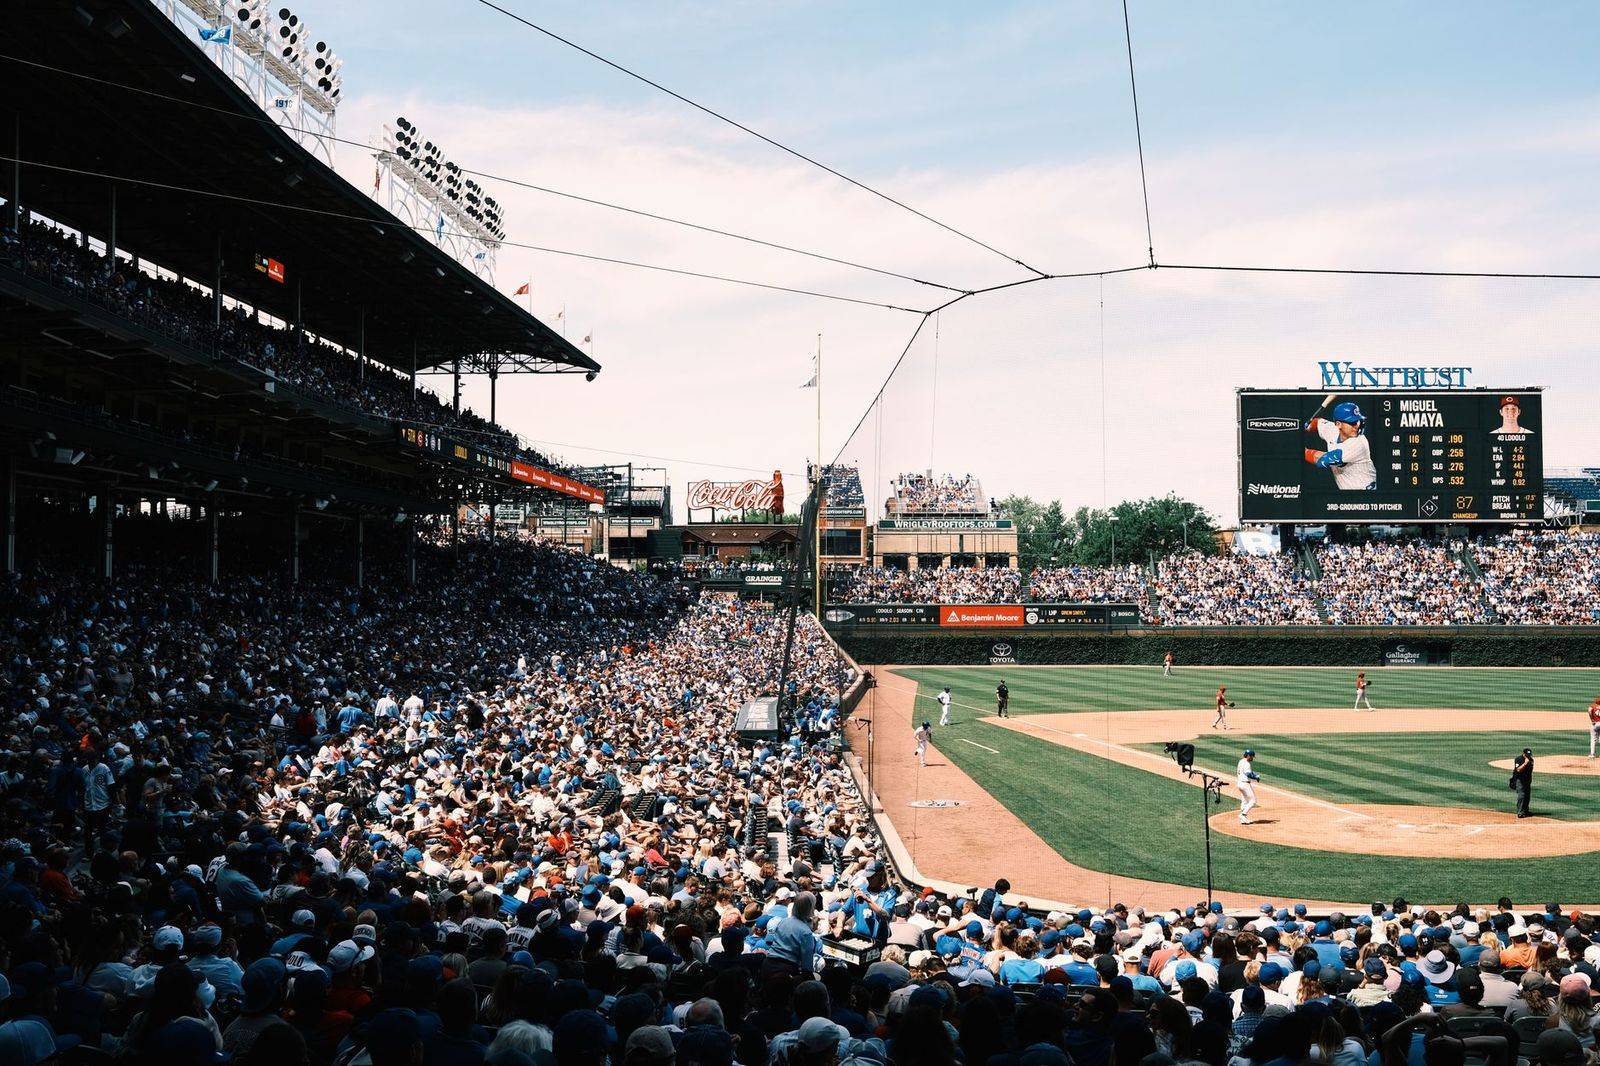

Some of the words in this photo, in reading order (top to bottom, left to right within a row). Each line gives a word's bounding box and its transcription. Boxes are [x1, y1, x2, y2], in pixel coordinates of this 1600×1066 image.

[1318, 362, 1472, 388] WINTRUST
[1384, 400, 1390, 412] 9
[1400, 400, 1438, 412] MIGUEL
[1384, 418, 1390, 426] C
[1400, 412, 1444, 428] AMAYA
[1409, 434, 1420, 443] 116
[1448, 434, 1463, 443] .190
[1412, 449, 1417, 457] 2
[1448, 449, 1464, 457] .256
[1411, 462, 1418, 471] 13
[1448, 462, 1464, 471] .276
[1412, 476, 1418, 484] 9
[1448, 476, 1464, 484] .532
[1260, 484, 1301, 494] National
[687, 480, 782, 512] Coca-Cola
[1456, 496, 1473, 509] 87
